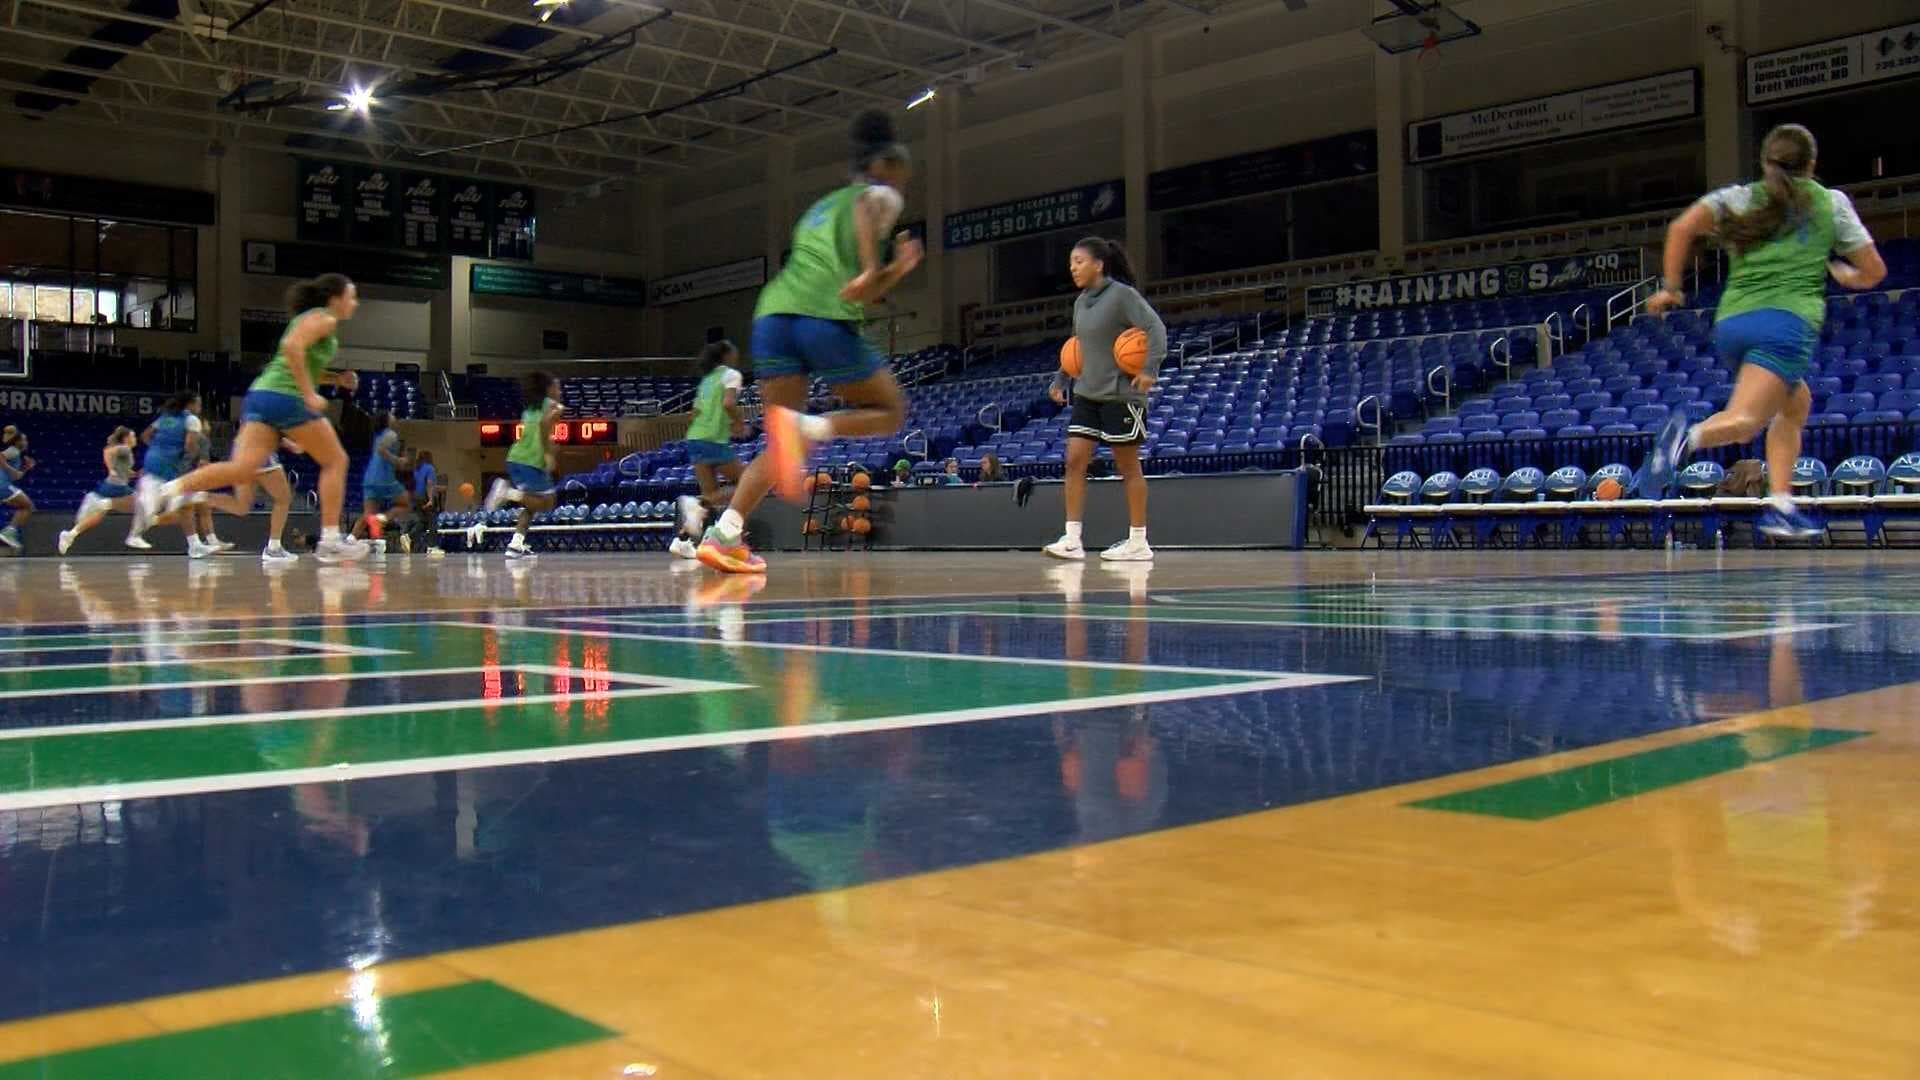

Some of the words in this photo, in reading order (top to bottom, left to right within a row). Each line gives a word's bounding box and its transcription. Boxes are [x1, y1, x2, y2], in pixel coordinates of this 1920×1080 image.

[1754, 67, 1788, 82] James
[1830, 55, 1849, 69] MD
[1754, 80, 1782, 96] Brett
[1444, 127, 1501, 143] Investment
[1556, 110, 1577, 123] LLC
[1470, 103, 1549, 126] McDermott
[950, 204, 1080, 243] 239.590.7145
